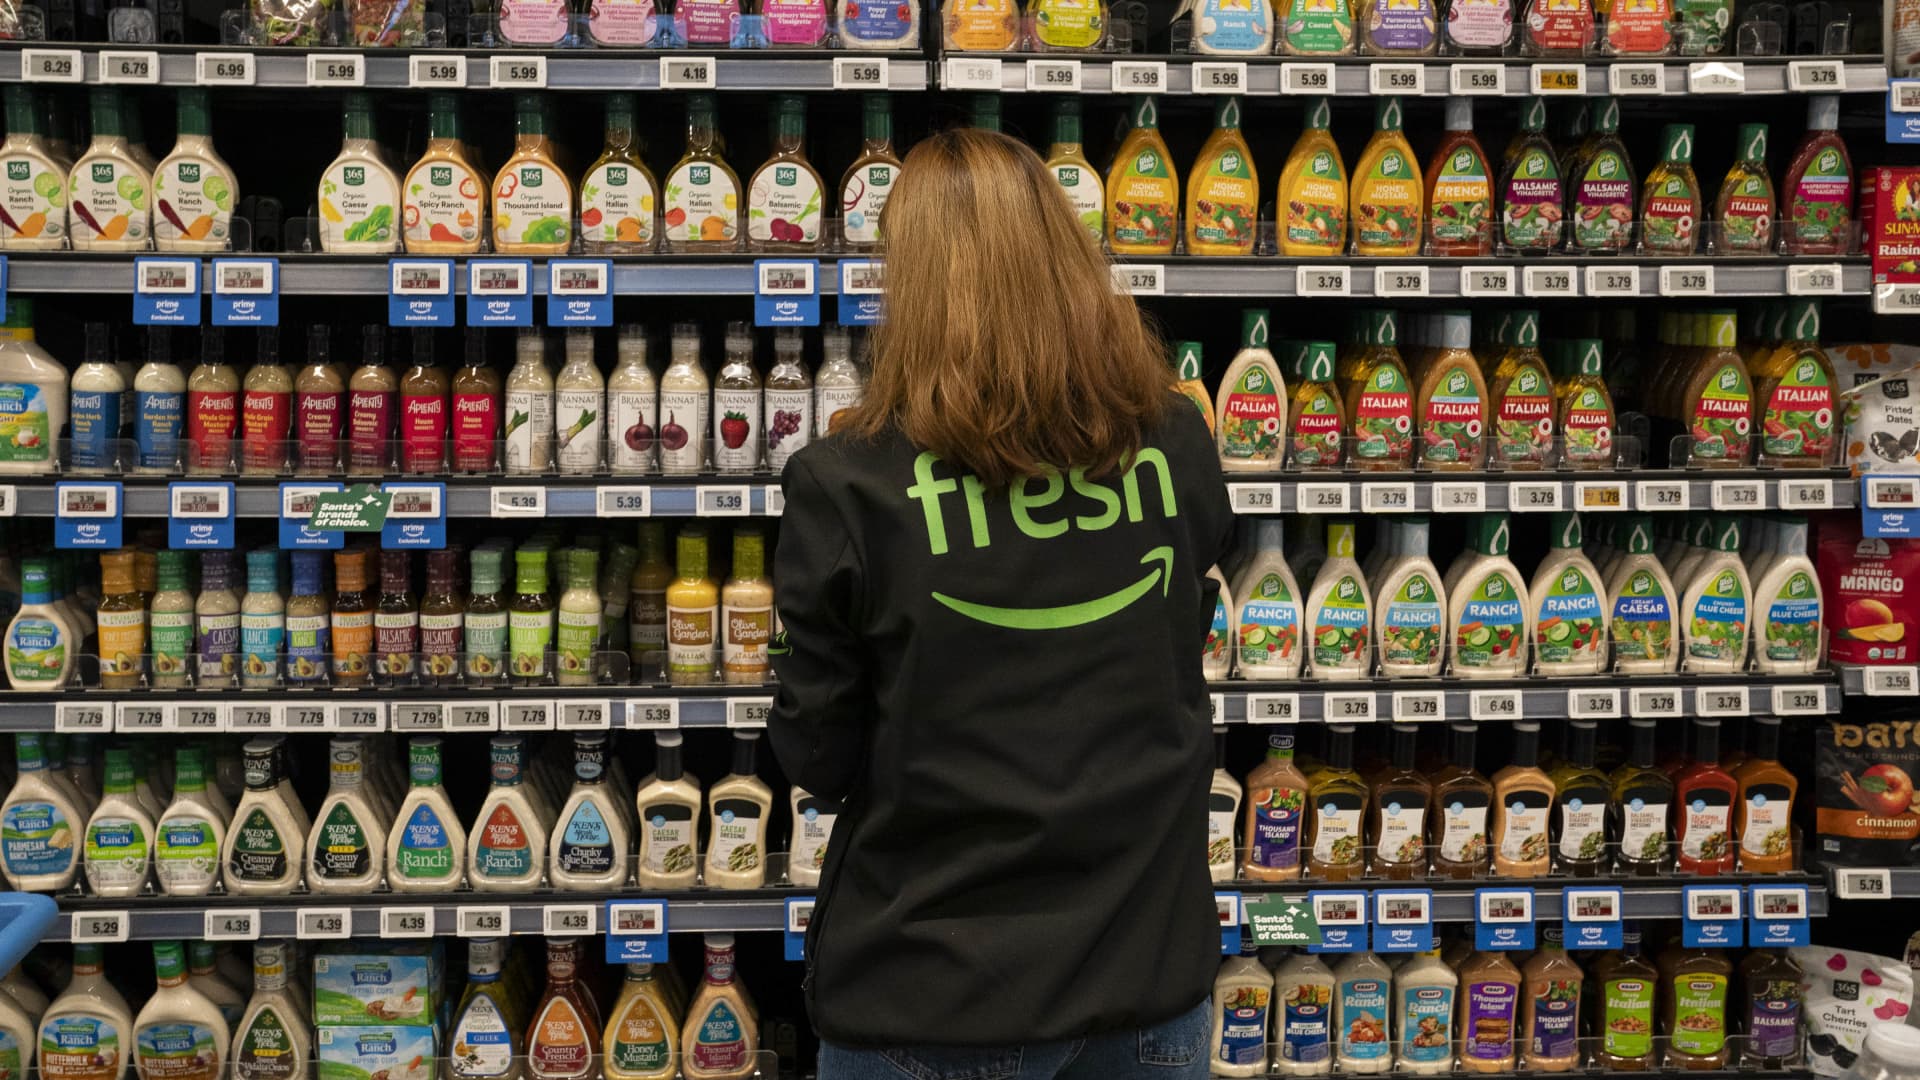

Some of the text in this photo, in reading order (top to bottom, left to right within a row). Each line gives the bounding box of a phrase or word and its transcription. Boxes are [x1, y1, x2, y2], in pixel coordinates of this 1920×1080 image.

[44, 61, 71, 73] 8.29
[122, 62, 148, 74] 6.79
[217, 64, 244, 75] 6.99
[328, 65, 355, 77] 5.99
[430, 67, 456, 78] 5.99
[683, 68, 706, 80] 4.18
[854, 69, 880, 80] 5.99
[967, 69, 993, 81] 5.99
[1047, 71, 1072, 82] 5.99
[1212, 73, 1238, 84] 5.99
[1301, 74, 1327, 85] 5.99
[1631, 74, 1656, 85] 5.99
[1811, 71, 1836, 83] 3.79
[1391, 74, 1416, 86] 5.99
[1556, 74, 1577, 86] 4.18
[180, 165, 199, 176] 365
[345, 167, 364, 179] 365
[433, 168, 452, 180] 365
[523, 170, 542, 181] 365
[608, 169, 627, 180] 365
[690, 168, 709, 180] 365
[776, 169, 795, 180] 365
[1437, 186, 1486, 197] FRENCH
[1512, 182, 1557, 192] BALSAMIC
[1584, 183, 1628, 193] BALSAMIC
[342, 201, 368, 209] Caesar
[419, 201, 440, 210] Spicy
[606, 200, 628, 208] Italian
[689, 199, 712, 207] Italian
[769, 201, 801, 209] Balsamic
[1652, 203, 1690, 213] ITALIAN
[1731, 202, 1767, 212] ITALIAN
[1132, 275, 1155, 287] 3.79
[1396, 277, 1420, 288] 3.79
[1483, 277, 1506, 288] 3.79
[1545, 277, 1568, 288] 3.79
[1682, 277, 1705, 288] 3.79
[1810, 275, 1833, 286] 3.79
[156, 300, 179, 310] prime
[233, 300, 255, 310] prime
[488, 301, 510, 310] prime
[569, 301, 590, 310] prime
[776, 301, 798, 310] prime
[1778, 390, 1828, 402] ITALIAN
[1362, 397, 1407, 408] ITALIAN
[1433, 404, 1479, 415] ITALIAN
[1505, 403, 1549, 415] ITALIAN
[1885, 406, 1913, 415] Pitted
[1301, 418, 1337, 427] ITALIAN
[1571, 415, 1607, 424] ITALIAN
[1887, 414, 1913, 424] Dates
[1248, 494, 1272, 505] 3.79
[1318, 494, 1341, 505] 2.59
[1383, 494, 1406, 505] 3.79
[1530, 492, 1554, 504] 3.79
[1599, 492, 1619, 503] 1.78
[1658, 491, 1681, 502] 3.79
[1734, 491, 1757, 502] 3.79
[1800, 489, 1824, 501] 6.49
[321, 503, 363, 512] Santa's
[511, 497, 536, 508] 5.39
[617, 496, 642, 508] 5.39
[315, 518, 370, 526] of choice.
[190, 524, 213, 534] prime
[1852, 568, 1893, 576] ORGANIC
[1840, 576, 1904, 592] MANGO
[1548, 597, 1595, 610] RANCH
[1620, 604, 1664, 614] CAESAR
[1248, 608, 1292, 619] RANCH
[1324, 609, 1364, 620] RANCH
[1470, 604, 1518, 616] RANCH
[1698, 605, 1744, 615] BLUE CHEESE
[19, 637, 51, 647] Ranch
[1886, 676, 1910, 687] 3.59
[1490, 700, 1514, 711] 6.49
[1590, 699, 1613, 710] 3.79
[1718, 697, 1741, 708] 3.79
[1794, 695, 1817, 707] 3.79
[1345, 702, 1368, 713] 3.79
[1414, 702, 1437, 713] 3.79
[77, 712, 102, 724] 7.79
[137, 712, 162, 724] 7.79
[246, 712, 271, 724] 7.79
[299, 712, 324, 724] 7.79
[352, 712, 376, 724] 7.79
[412, 712, 436, 723] 7.79
[522, 711, 546, 722] 7.79
[577, 710, 601, 721] 7.79
[646, 709, 670, 721] 5.39
[18, 818, 48, 829] Ranch
[1856, 816, 1917, 828] cinnamon
[652, 829, 679, 837] CAESAR
[720, 825, 746, 834] CAESAR
[1259, 825, 1296, 833] THOUSAND
[100, 835, 130, 845] Ranch
[170, 835, 201, 845] Ranch
[571, 847, 602, 858] Chunky
[402, 851, 448, 866] Ranch
[485, 855, 522, 867] Ranch
[564, 855, 609, 865] Blue Cheese
[1860, 879, 1882, 891] 5.79
[316, 919, 342, 930] 4.39
[476, 916, 501, 928] 4.39
[562, 916, 588, 927] 4.39
[1253, 915, 1293, 924] Santa's
[93, 922, 118, 933] 5.29
[225, 920, 250, 932] 4.39
[1256, 923, 1293, 932] brands
[1258, 932, 1310, 940] of choice.
[356, 972, 386, 984] Ranch
[1345, 995, 1384, 1007] Ranch
[1473, 994, 1512, 1003] Thousand
[1608, 998, 1650, 1009] Italian
[1680, 997, 1721, 1008] Italian
[1409, 1002, 1449, 1014] Ranch
[1480, 1003, 1505, 1011] Island
[1836, 1006, 1856, 1016] Tart
[1754, 1017, 1796, 1027] BALSAMIC
[1822, 1012, 1868, 1029] Cherries
[60, 1033, 94, 1045] Ranch
[474, 1034, 499, 1042] GREEK
[157, 1040, 191, 1051] Ranch
[359, 1042, 391, 1054] Ranch
[542, 1045, 578, 1056] Country
[627, 1044, 655, 1054] Honey
[701, 1044, 739, 1054] Thousand
[545, 1052, 576, 1061] French
[623, 1052, 658, 1061] Mustard
[708, 1053, 731, 1061] Island
